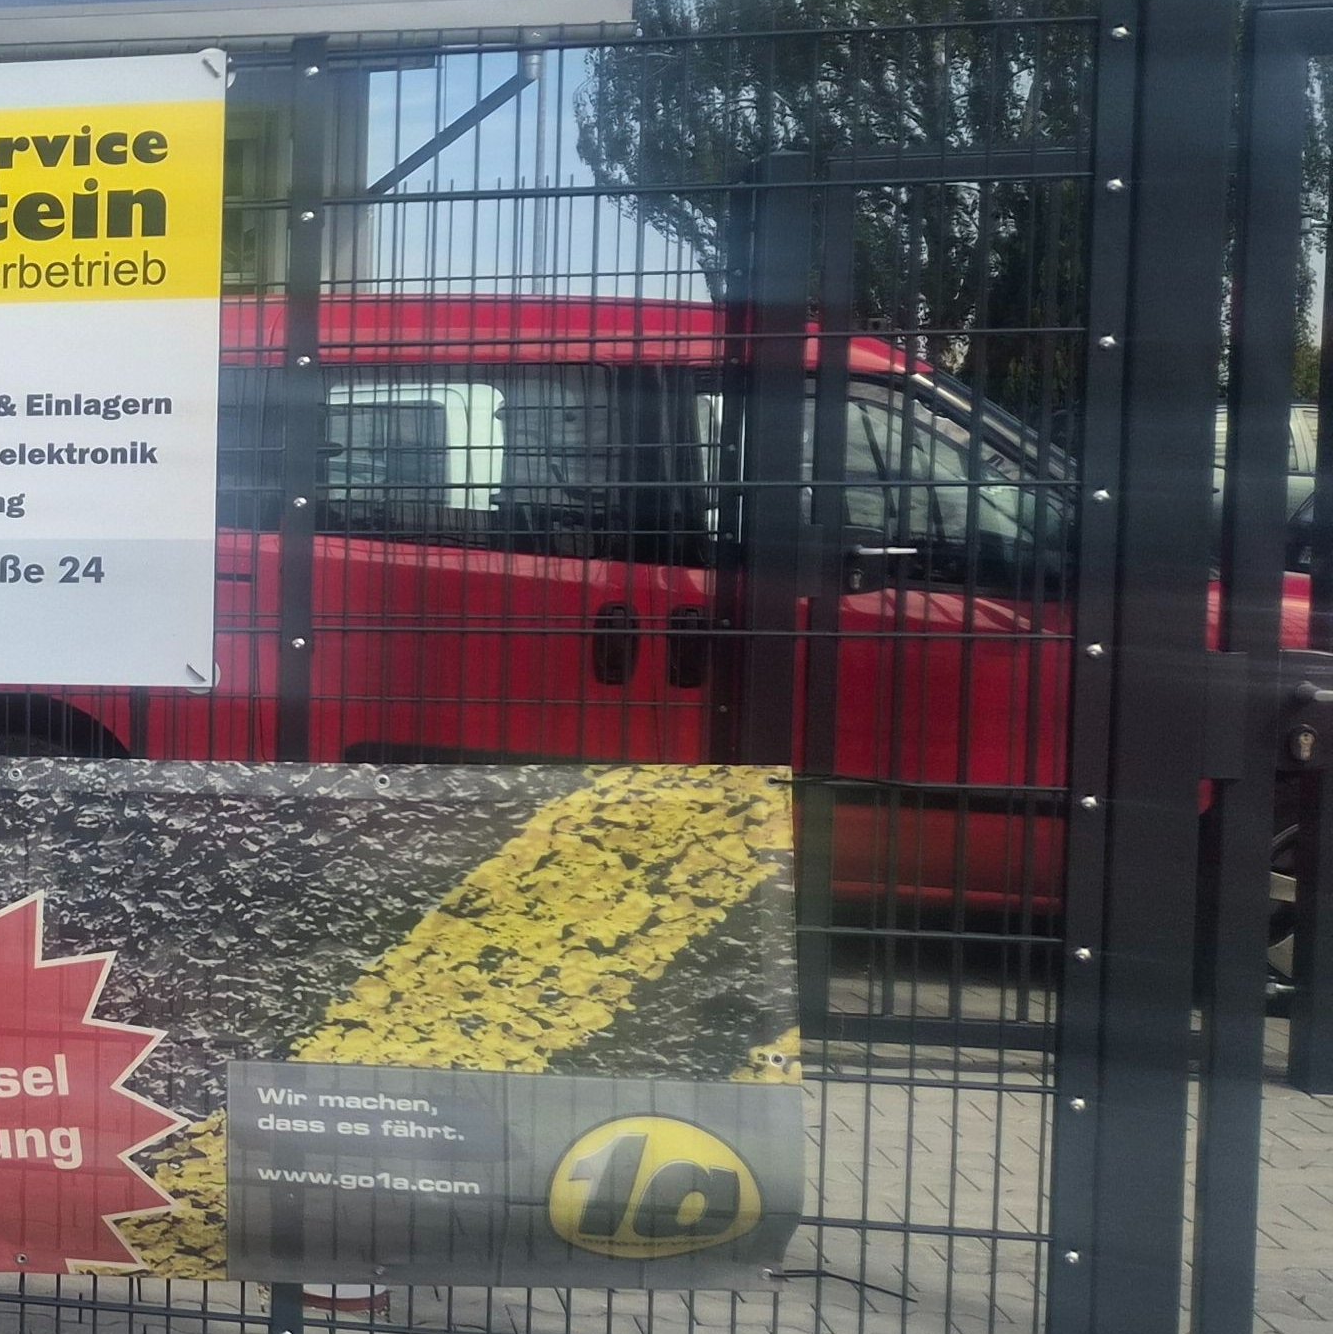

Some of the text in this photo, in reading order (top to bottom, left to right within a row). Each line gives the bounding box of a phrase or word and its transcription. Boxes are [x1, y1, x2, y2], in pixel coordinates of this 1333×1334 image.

[26, 393, 172, 420] Einlagern
[0, 442, 158, 466] elektronik
[58, 556, 105, 584] 24
[257, 1087, 439, 1116] Wir machen,
[257, 1114, 465, 1141] dass es fährt.
[257, 1168, 480, 1196] www.go1a.com
[569, 1133, 740, 1239] 1a
